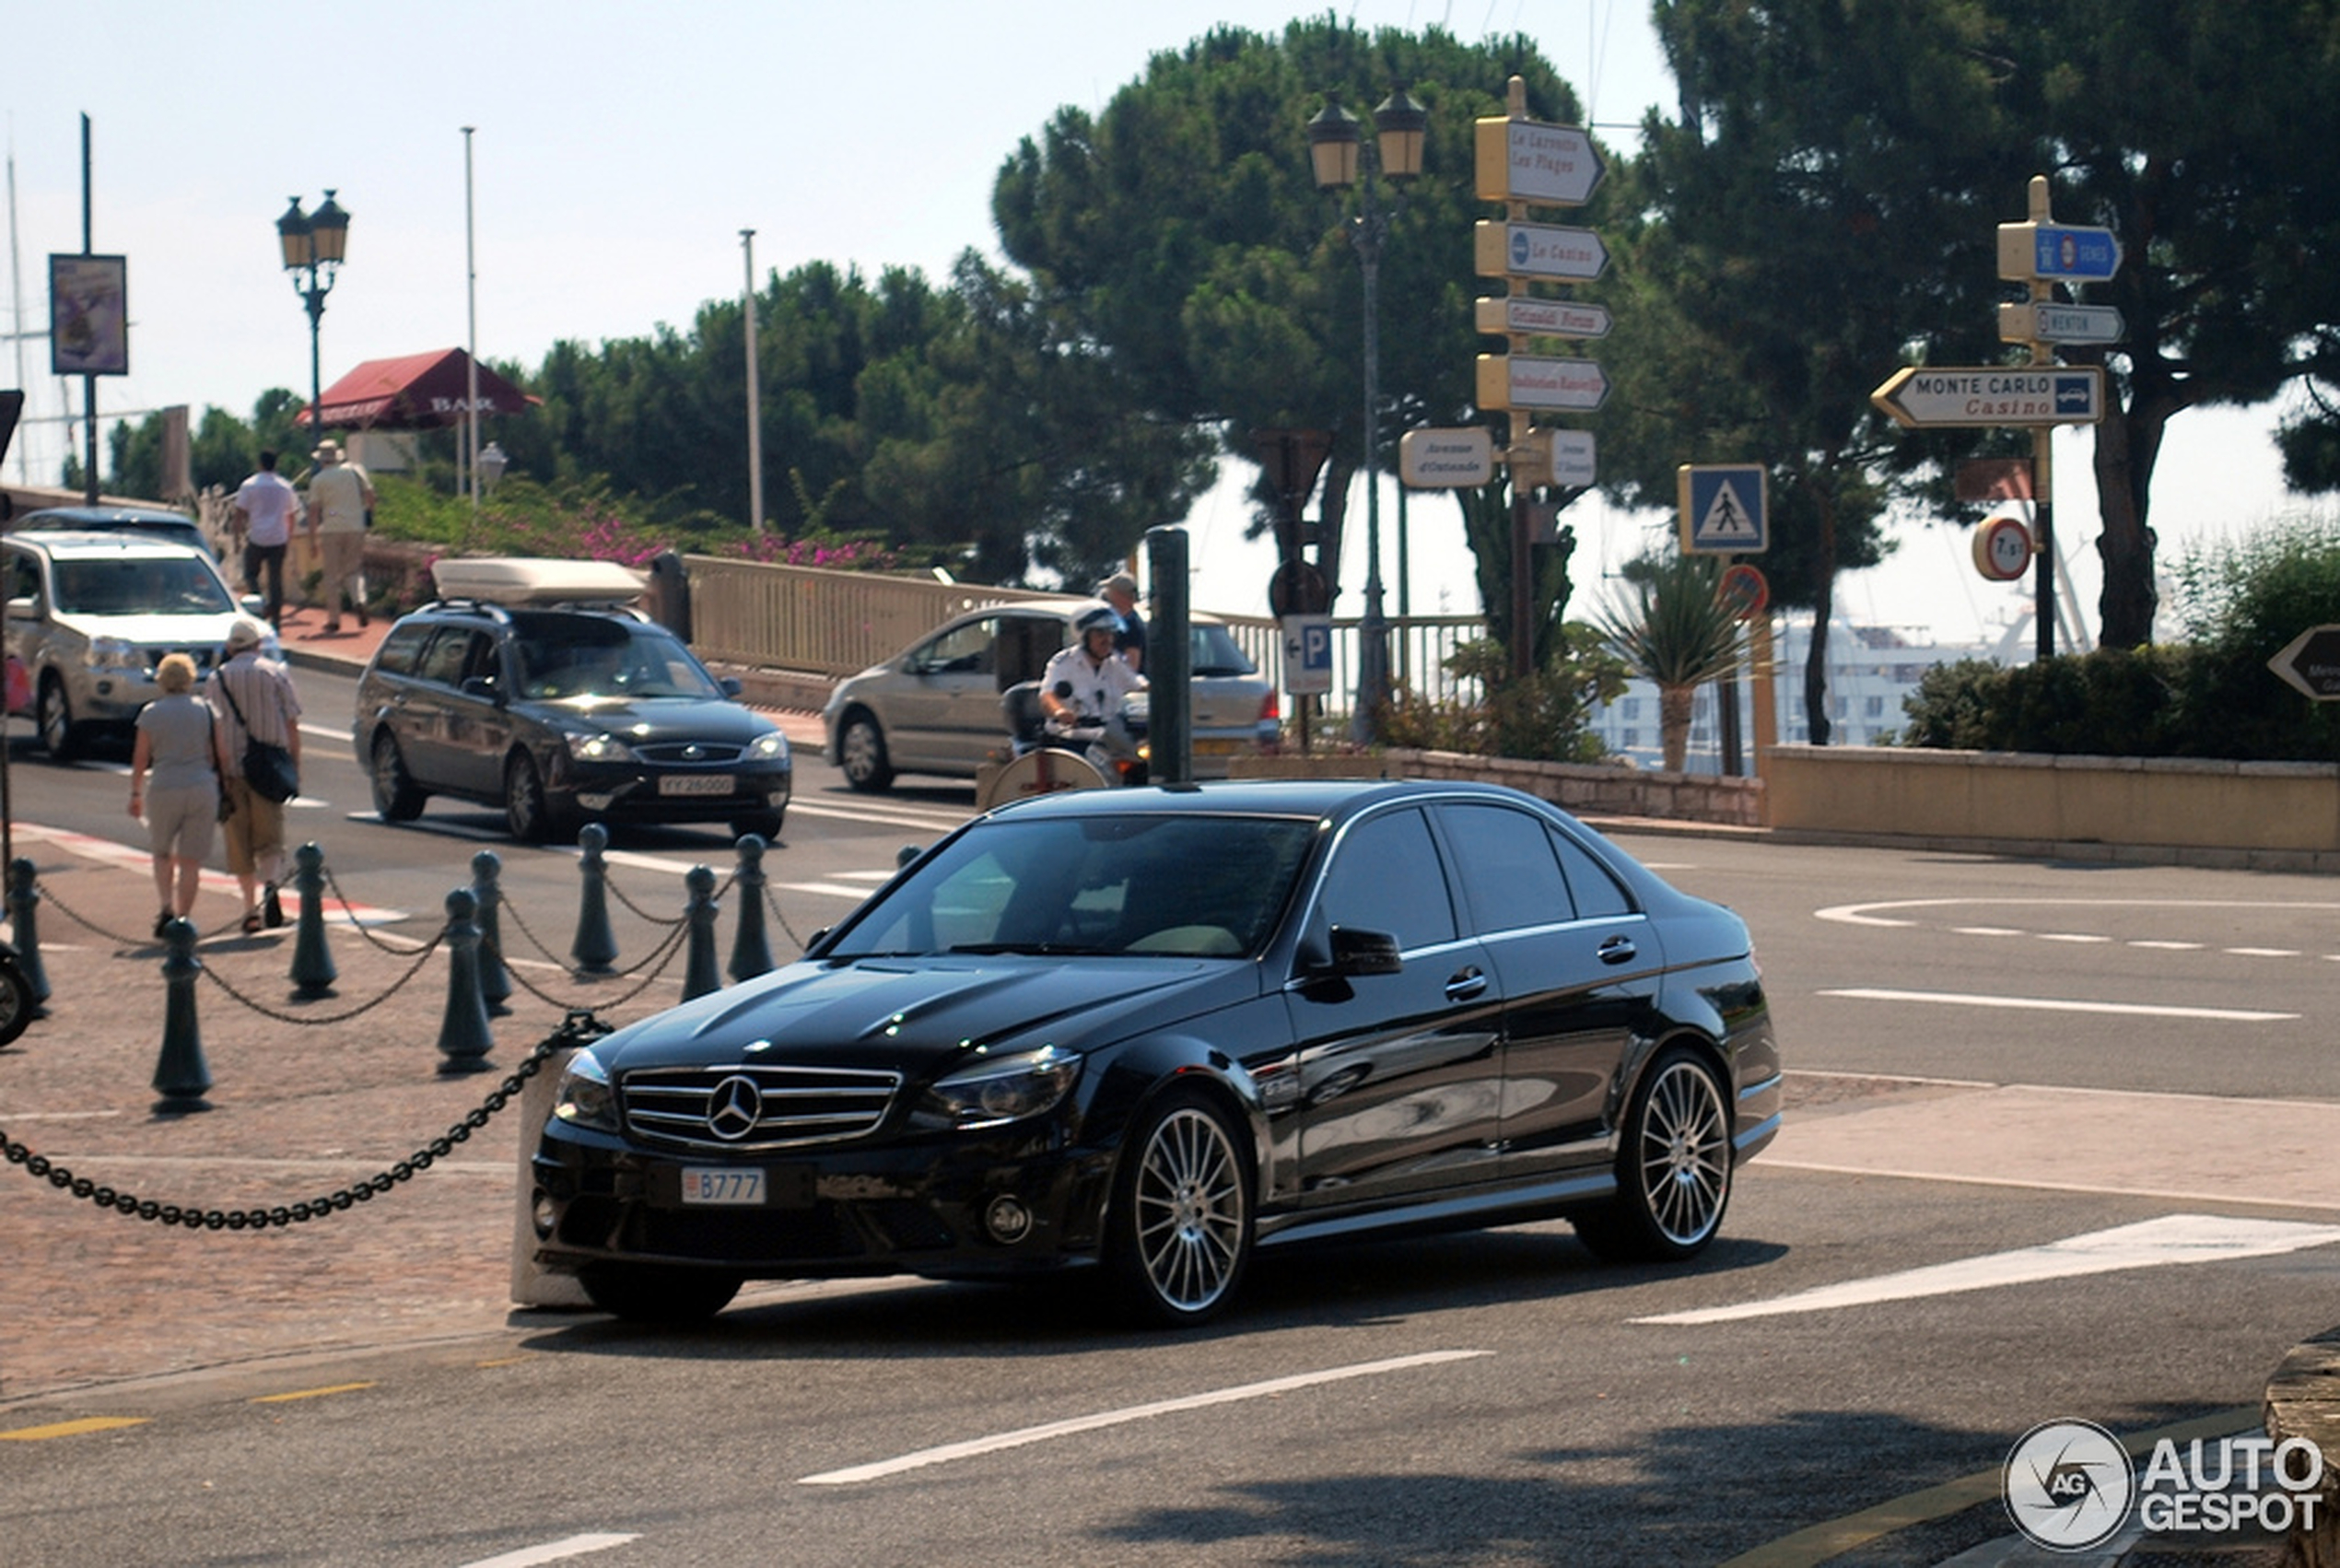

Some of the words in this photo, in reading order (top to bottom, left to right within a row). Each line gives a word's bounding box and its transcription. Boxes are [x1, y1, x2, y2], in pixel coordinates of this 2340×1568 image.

[1532, 240, 1547, 259] Le
[1550, 243, 1592, 263] Casino
[1916, 378, 1980, 394] MONTE
[1988, 378, 2050, 394] CARLO
[430, 397, 496, 412] BAR
[1965, 398, 2050, 415] Casino
[1424, 443, 1473, 455] Avenue
[1306, 629, 1325, 665] P
[701, 1173, 760, 1199] B777
